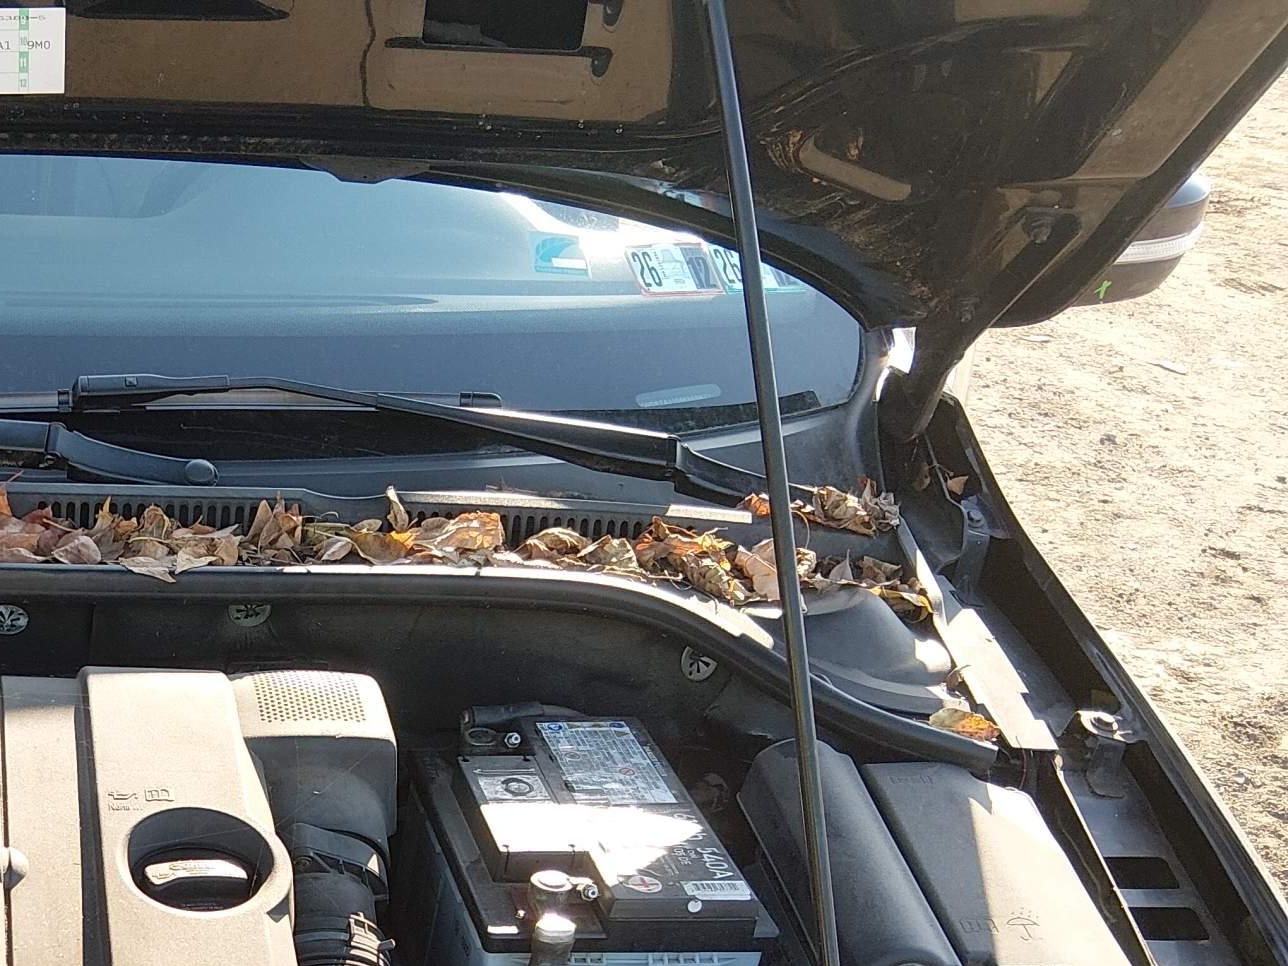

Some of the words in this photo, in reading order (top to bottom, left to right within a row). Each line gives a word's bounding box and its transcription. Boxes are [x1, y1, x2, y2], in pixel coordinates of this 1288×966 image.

[20, 78, 27, 88] 12
[631, 251, 663, 288] 26
[697, 847, 734, 879] 540A
